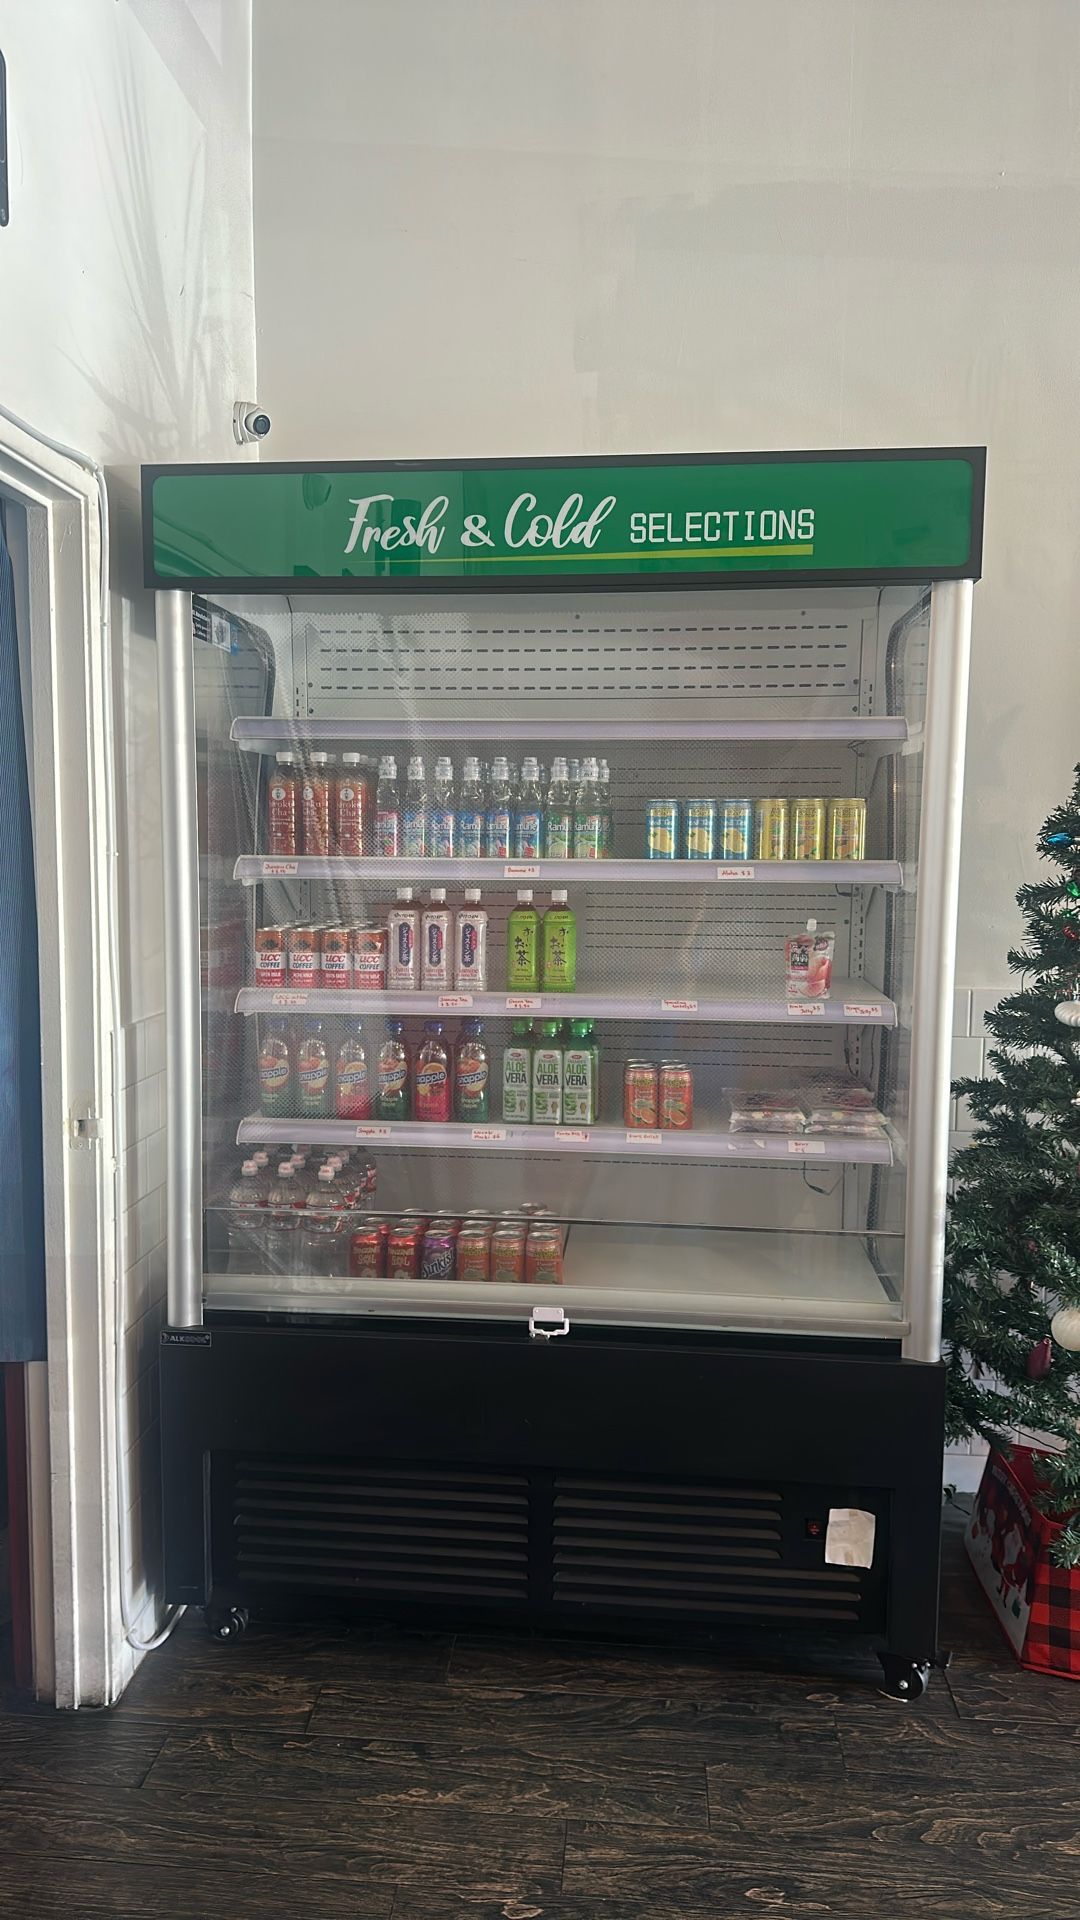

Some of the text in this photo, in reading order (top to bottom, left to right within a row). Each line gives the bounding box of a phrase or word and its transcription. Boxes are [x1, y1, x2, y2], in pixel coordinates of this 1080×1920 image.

[344, 493, 815, 553] Fresh & Cold SELECTIONS
[261, 953, 281, 962] UCC
[293, 953, 314, 962] UCC
[326, 954, 346, 962] UCC
[360, 955, 380, 963] UCC
[506, 1061, 526, 1072] ALOE
[537, 1063, 558, 1074] ALOE
[565, 1063, 587, 1074] ALOE
[505, 1072, 527, 1083] VERA
[536, 1074, 559, 1085] VERA
[565, 1075, 587, 1086] VERA
